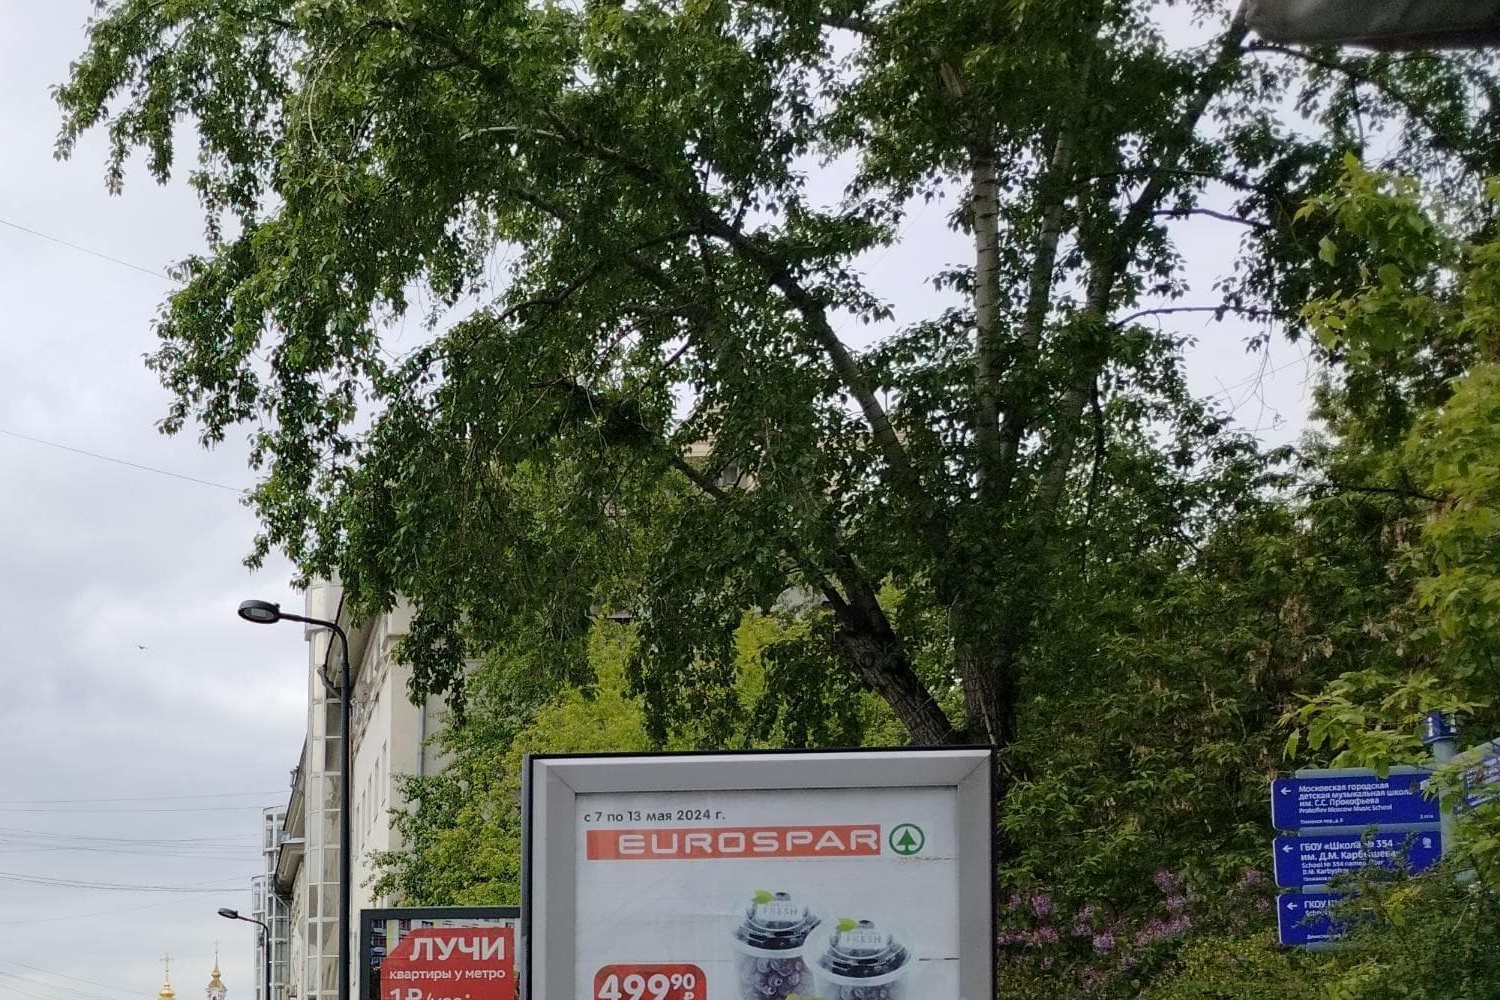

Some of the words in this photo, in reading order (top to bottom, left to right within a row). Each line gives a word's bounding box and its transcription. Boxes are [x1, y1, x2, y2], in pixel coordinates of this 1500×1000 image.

[1299, 785, 1346, 793] Московская
[1348, 782, 1389, 792] городская
[1298, 793, 1331, 801] детская
[1332, 790, 1386, 800] музыкальная
[1329, 798, 1380, 807] Прокофьева
[584, 814, 592, 822] с
[595, 811, 603, 822] 7
[607, 813, 624, 822] по
[627, 811, 642, 822] 13
[646, 811, 673, 821] мая
[676, 809, 712, 821] 2024
[715, 810, 726, 821] г.
[618, 829, 878, 855] EUROSPAR
[1300, 842, 1323, 852] ГБОУ
[1323, 841, 1361, 851] «Школа
[1376, 839, 1393, 848] 354
[1300, 853, 1318, 861] им.
[1319, 851, 1340, 861] Д.М.
[1301, 861, 1323, 869] School
[1304, 900, 1327, 909] ГКОУ
[410, 937, 505, 961] ЛУЧИ
[389, 970, 452, 981] квартиры
[454, 970, 463, 981] у
[465, 969, 506, 980] метро
